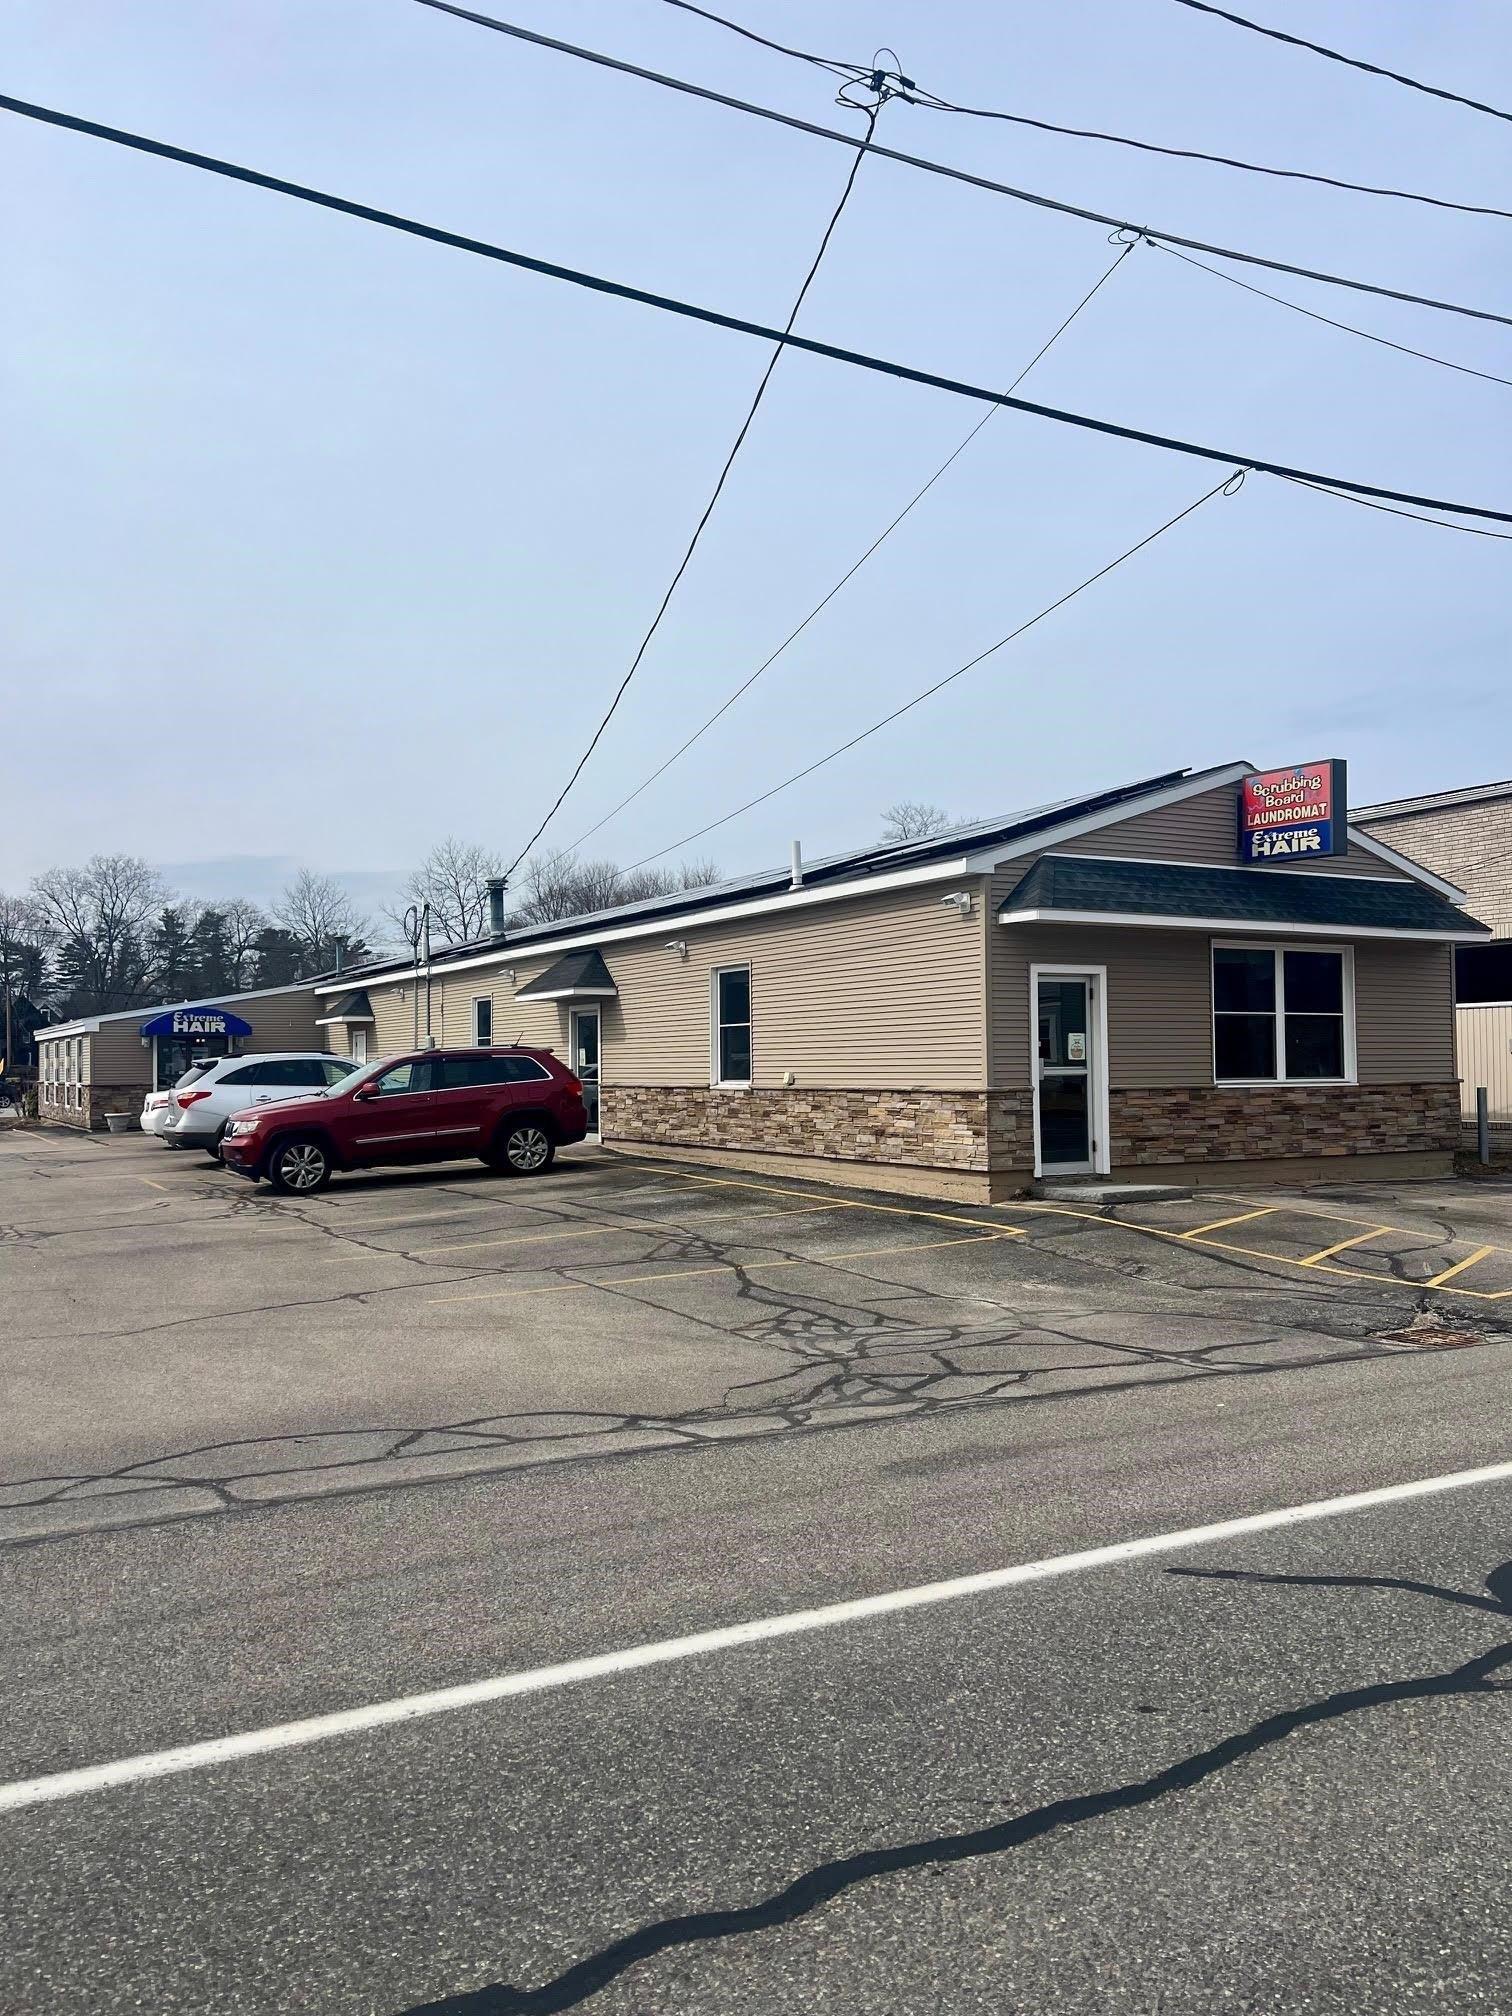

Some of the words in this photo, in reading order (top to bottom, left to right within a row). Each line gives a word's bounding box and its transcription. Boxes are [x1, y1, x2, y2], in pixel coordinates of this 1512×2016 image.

[1252, 775, 1322, 797] Scrubbing
[1265, 790, 1305, 808] Board
[1247, 802, 1328, 827] LAUNDROMAT
[1251, 828, 1318, 844] Extreme
[1251, 835, 1321, 858] HAIR
[173, 1011, 224, 1022] Extreme
[173, 1021, 226, 1033] HAIR
